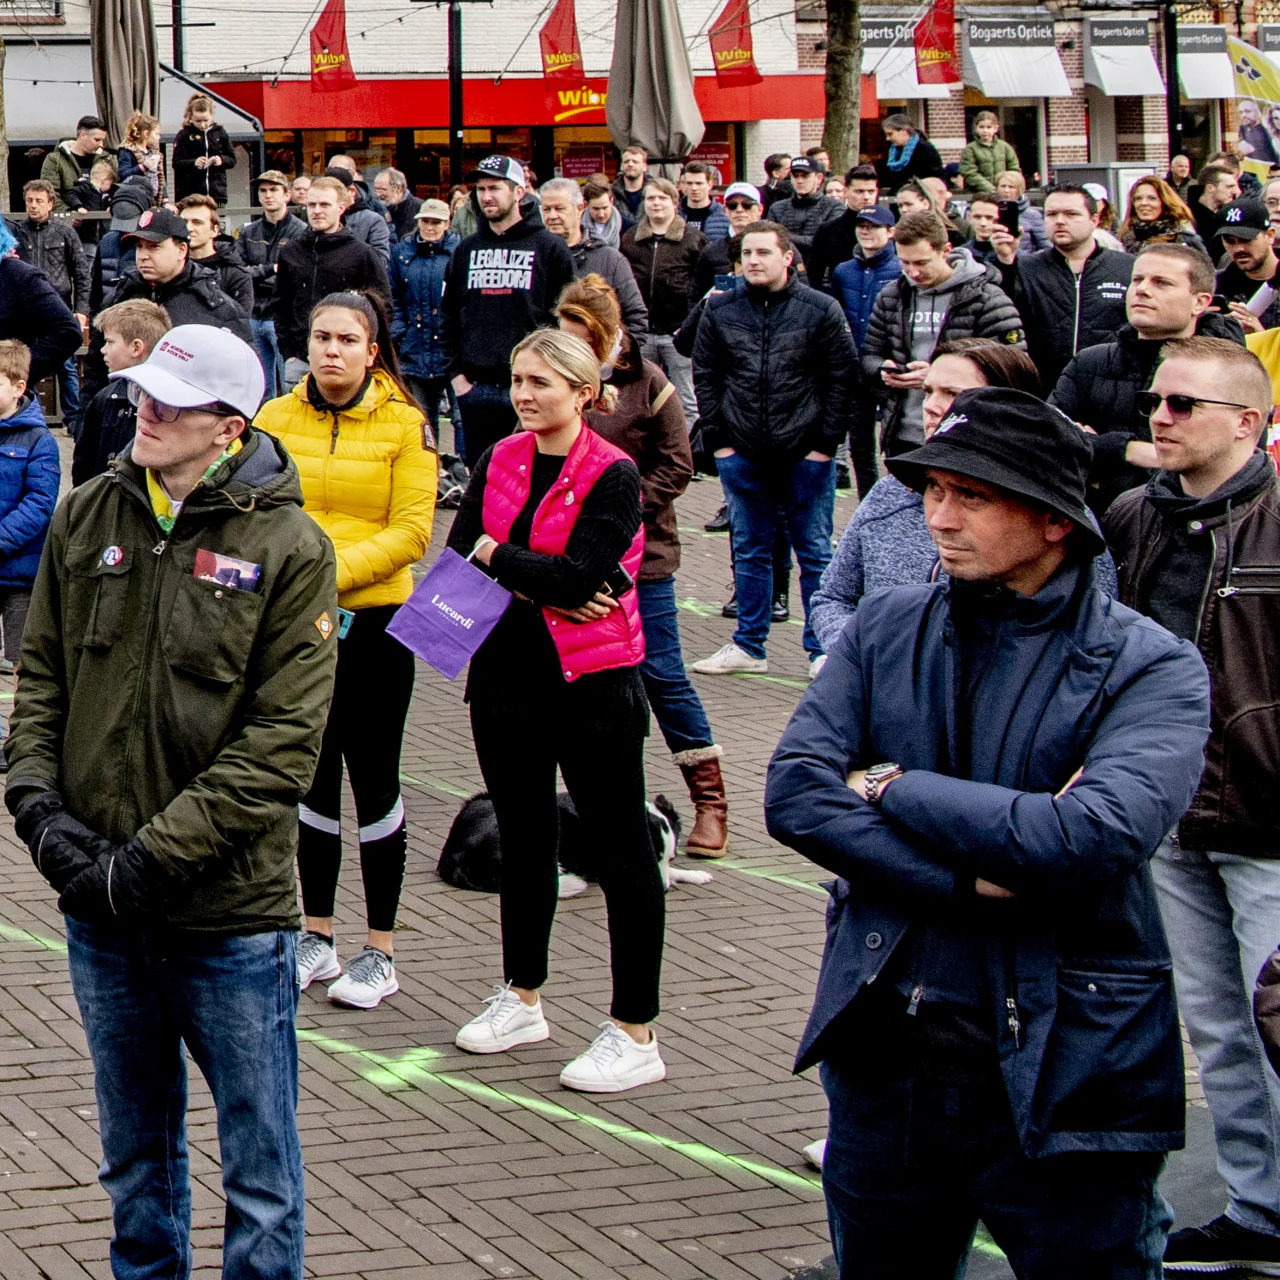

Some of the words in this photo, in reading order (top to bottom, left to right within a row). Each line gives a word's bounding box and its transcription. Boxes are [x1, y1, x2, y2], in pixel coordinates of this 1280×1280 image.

[860, 25, 894, 42] gaerts
[895, 24, 915, 41] Opt
[970, 25, 1017, 42] Bogaerts
[1017, 24, 1053, 40] Optiek
[1093, 27, 1122, 38] Bogaerts
[1122, 27, 1145, 38] Optiek
[1178, 35, 1202, 45] ogaerts
[1201, 34, 1223, 45] Optiek
[557, 85, 608, 107] Wibr
[470, 248, 535, 270] LEGALIZE
[467, 269, 532, 290] FREEDOM
[431, 594, 475, 630] Lucardi
